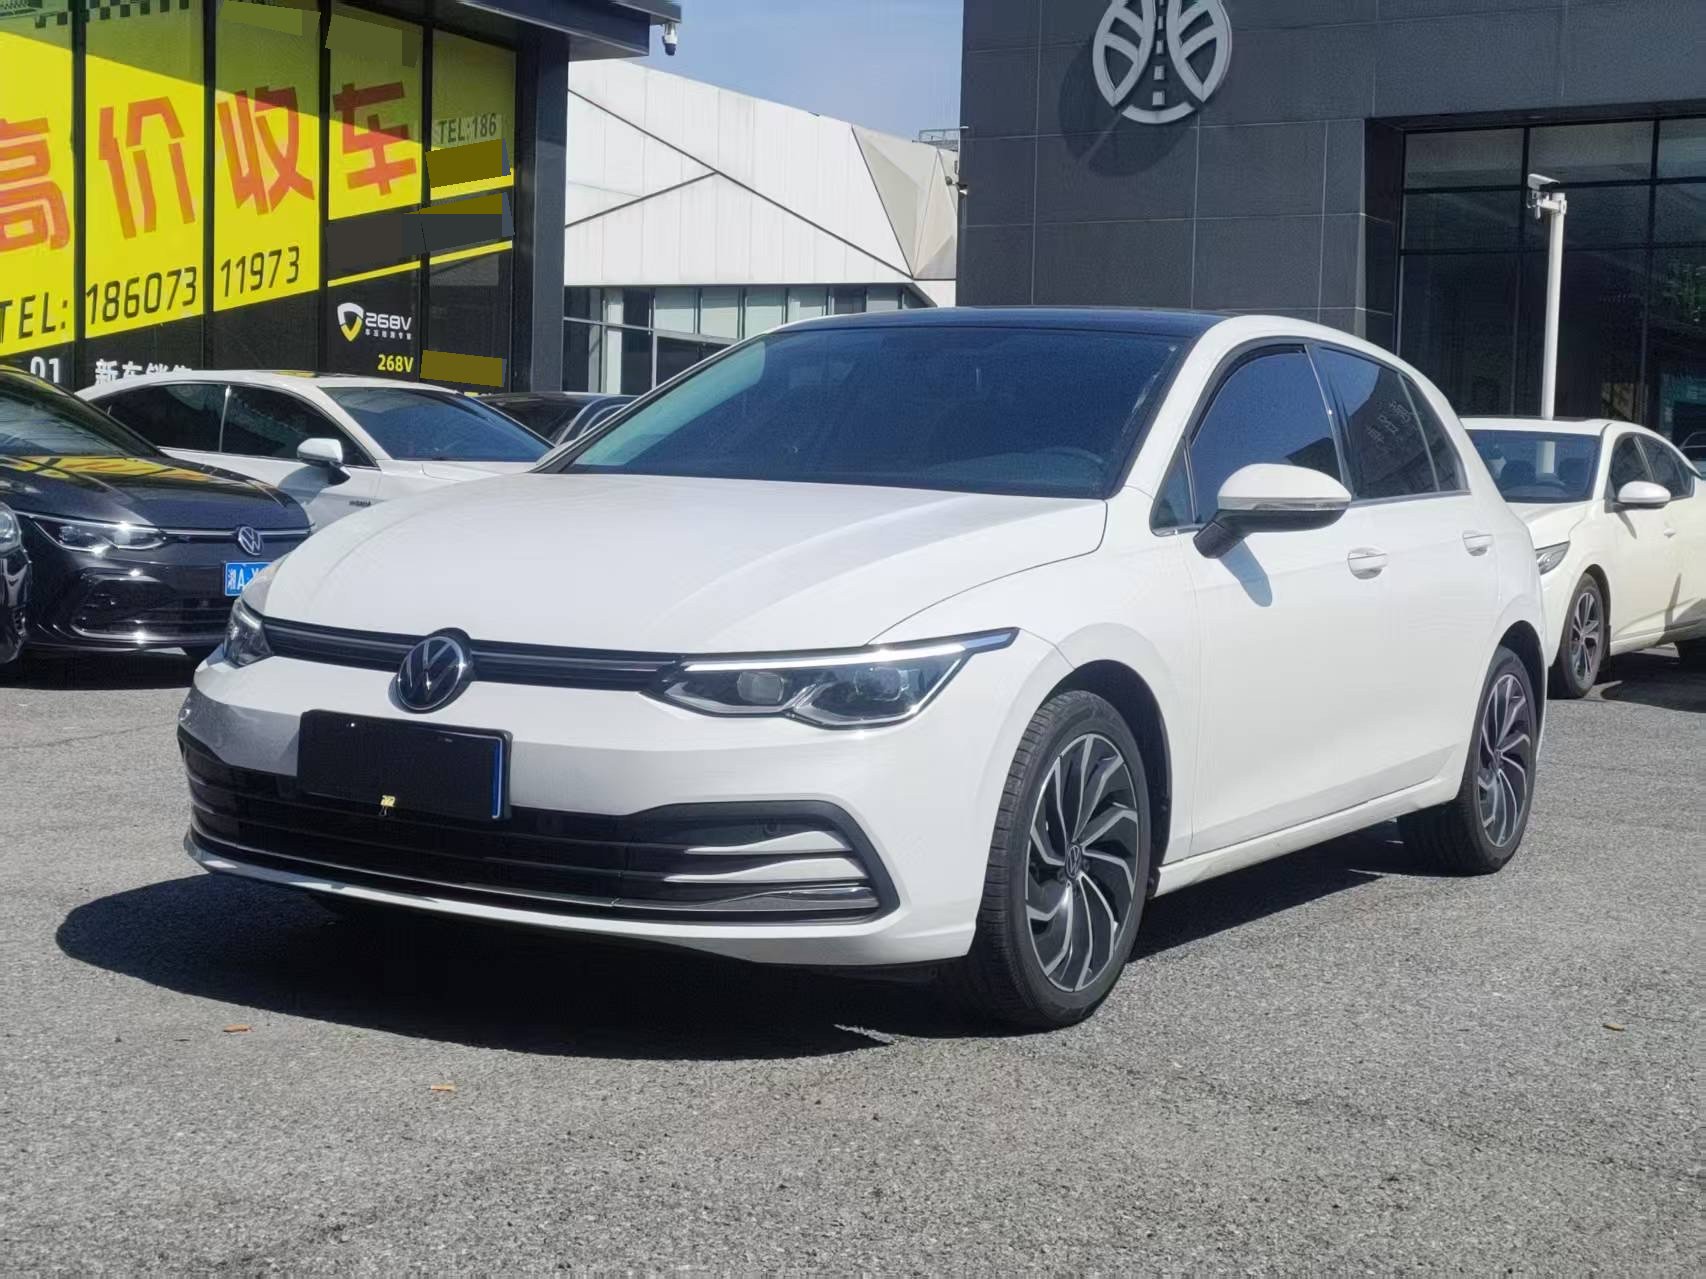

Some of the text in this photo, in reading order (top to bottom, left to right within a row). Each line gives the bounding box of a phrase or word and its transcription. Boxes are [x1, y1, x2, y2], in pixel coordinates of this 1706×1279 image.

[438, 112, 497, 145] TEL:186
[86, 266, 197, 325] 186073
[220, 245, 300, 297] 11973
[365, 312, 412, 331] 268V
[30, 356, 60, 384] 01
[377, 353, 414, 373] 268V
